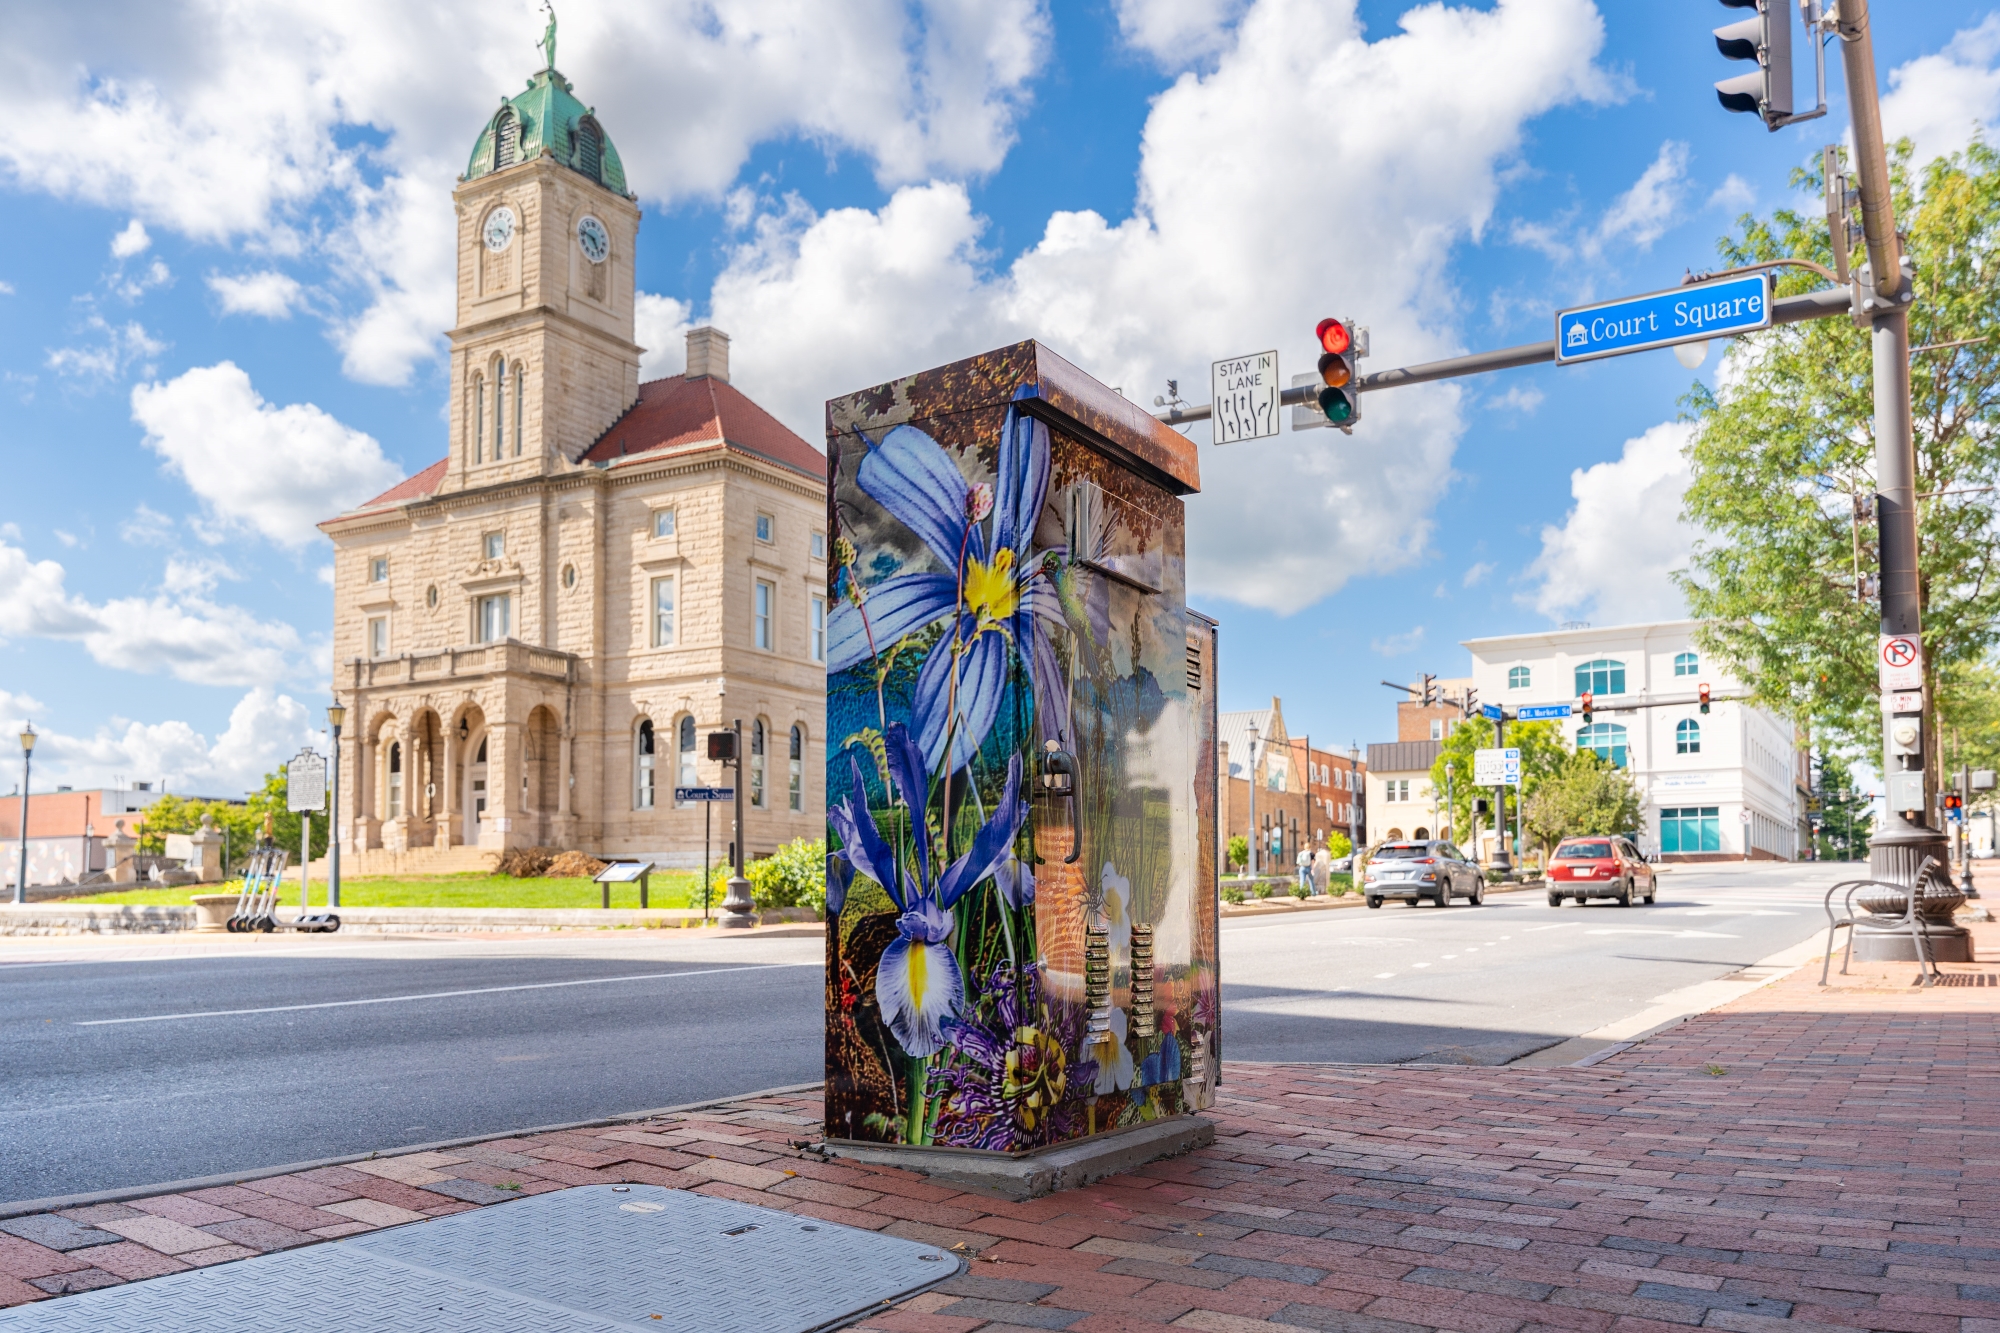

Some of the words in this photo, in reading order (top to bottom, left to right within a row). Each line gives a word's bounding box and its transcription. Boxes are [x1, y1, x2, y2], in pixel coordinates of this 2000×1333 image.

[1591, 310, 1659, 342] Court
[1674, 294, 1761, 328] Square
[1220, 359, 1251, 377] STAY
[1258, 356, 1270, 370] IN
[1228, 373, 1262, 391] LANE
[1534, 708, 1559, 717] Market
[1561, 707, 1570, 716] St
[684, 789, 709, 800] Court
[711, 789, 734, 800] Squar
